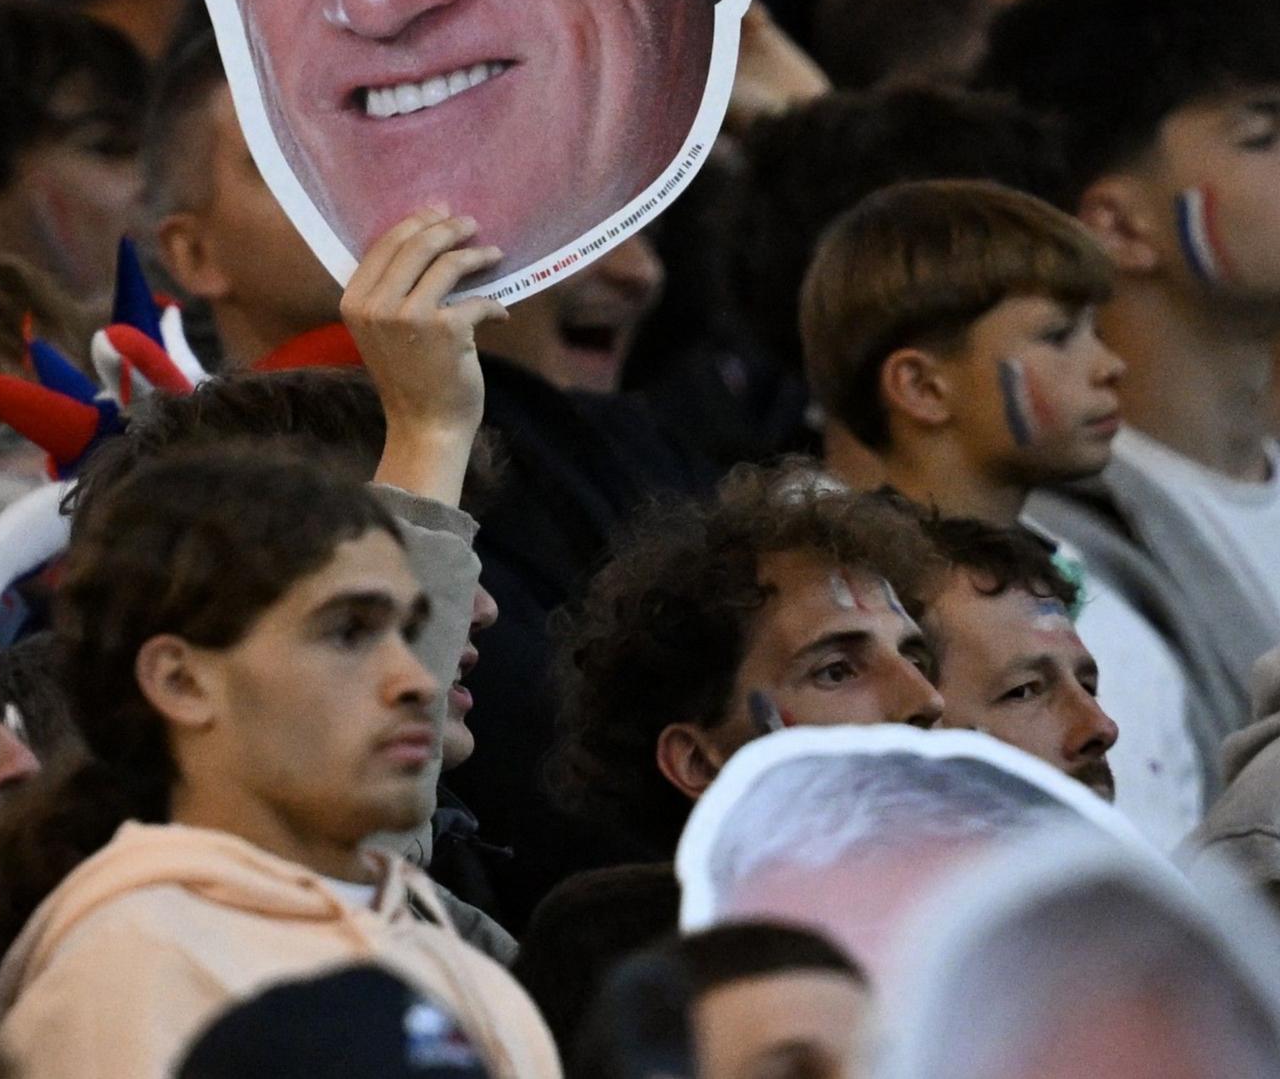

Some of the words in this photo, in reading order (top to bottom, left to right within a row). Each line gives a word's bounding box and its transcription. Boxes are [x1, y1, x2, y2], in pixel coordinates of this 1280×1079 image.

[520, 278, 530, 288] la
[552, 253, 578, 272] minute
[578, 235, 607, 257] lorsque
[606, 226, 620, 238] les
[620, 198, 658, 230] supporters
